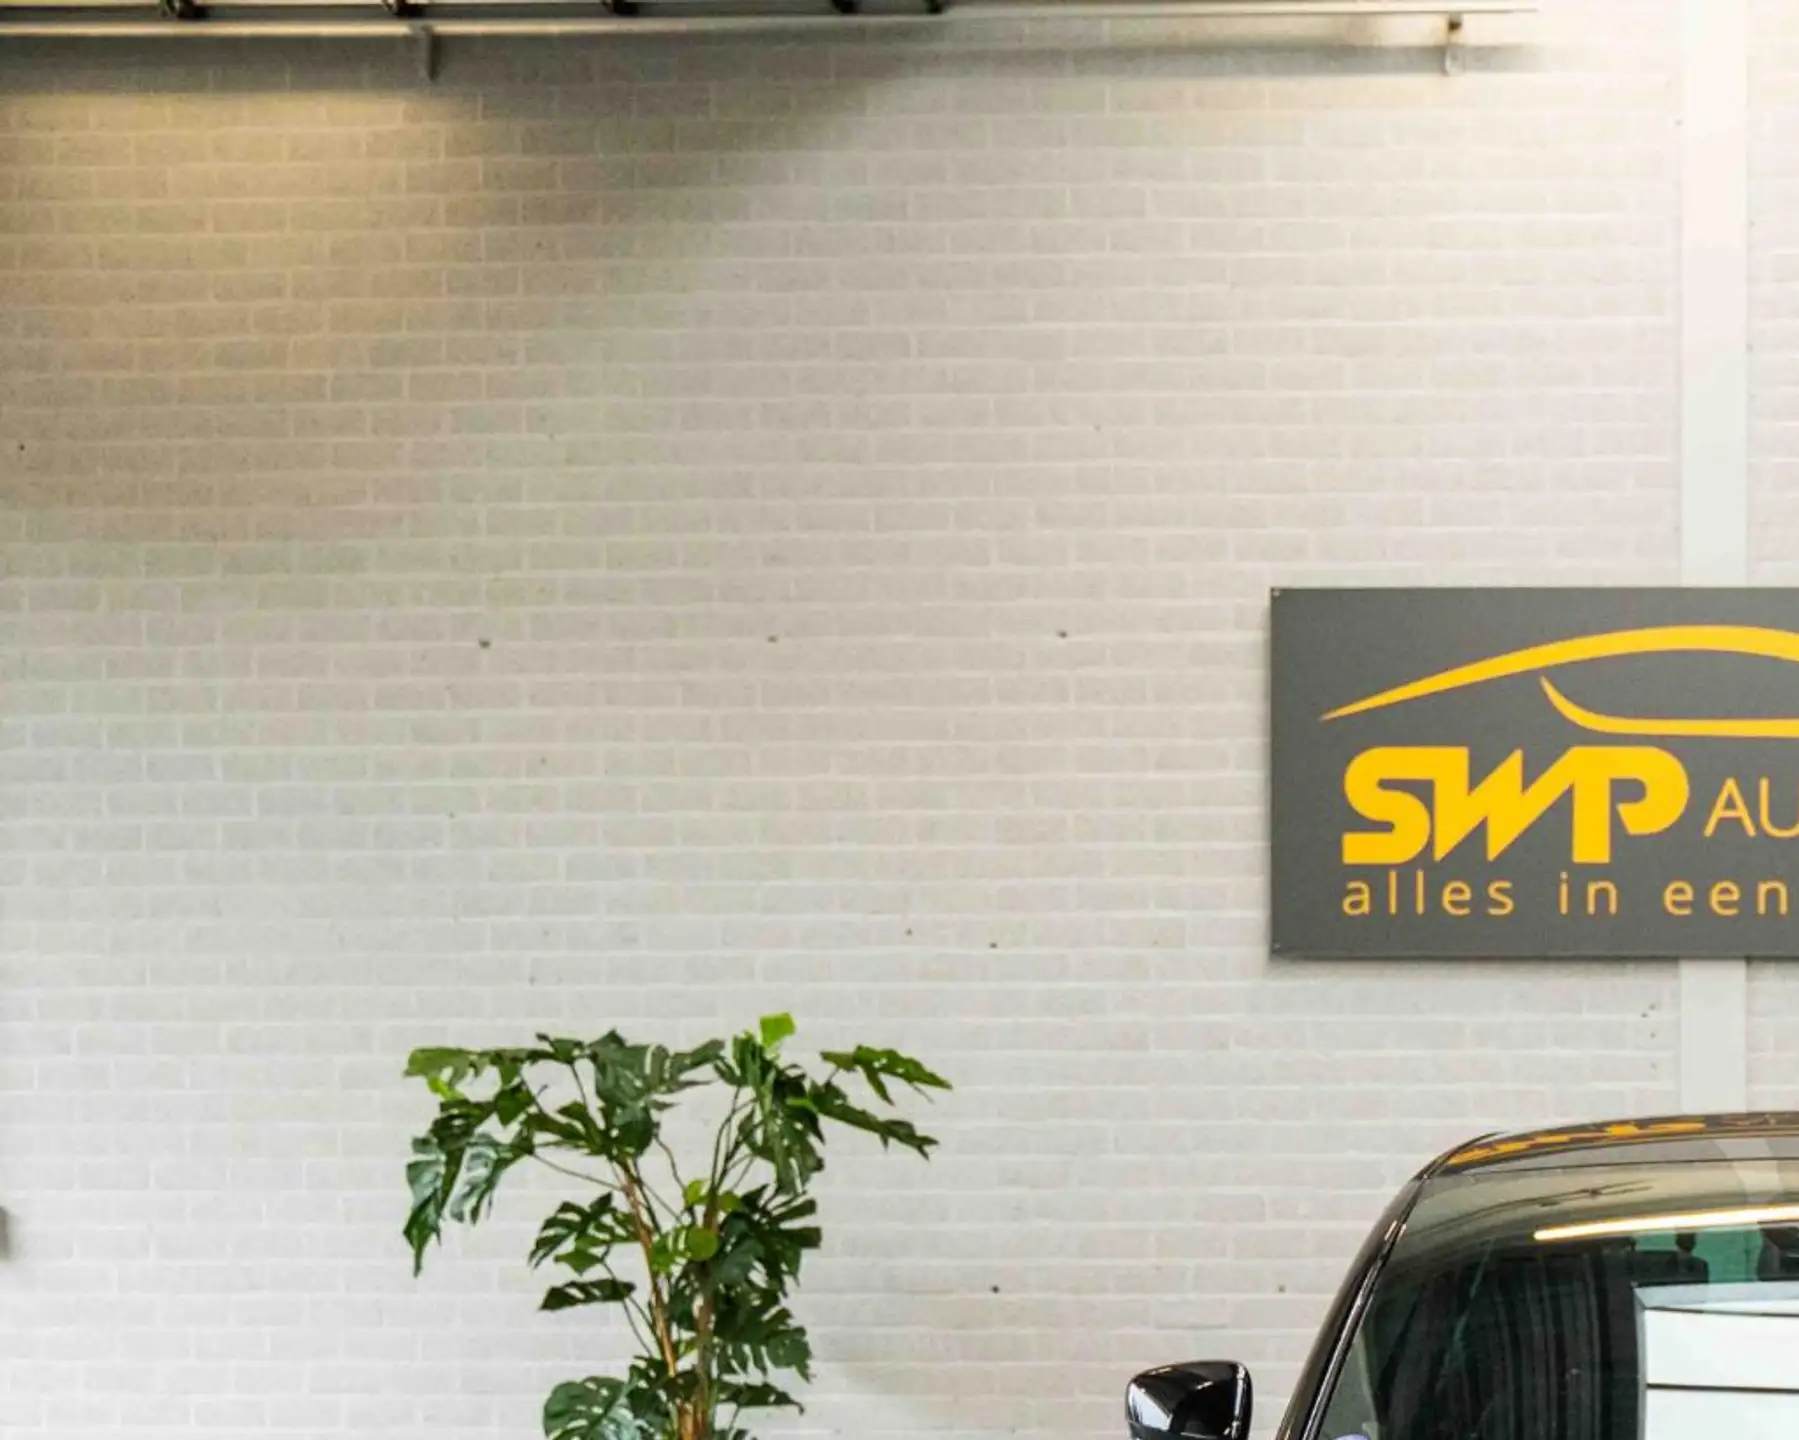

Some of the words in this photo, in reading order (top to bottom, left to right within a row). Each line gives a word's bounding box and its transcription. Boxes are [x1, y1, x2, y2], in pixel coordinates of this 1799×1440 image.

[1342, 745, 1689, 866] SWP
[1341, 870, 1515, 917] alles
[1558, 872, 1620, 917] in
[1662, 876, 1791, 917] een
